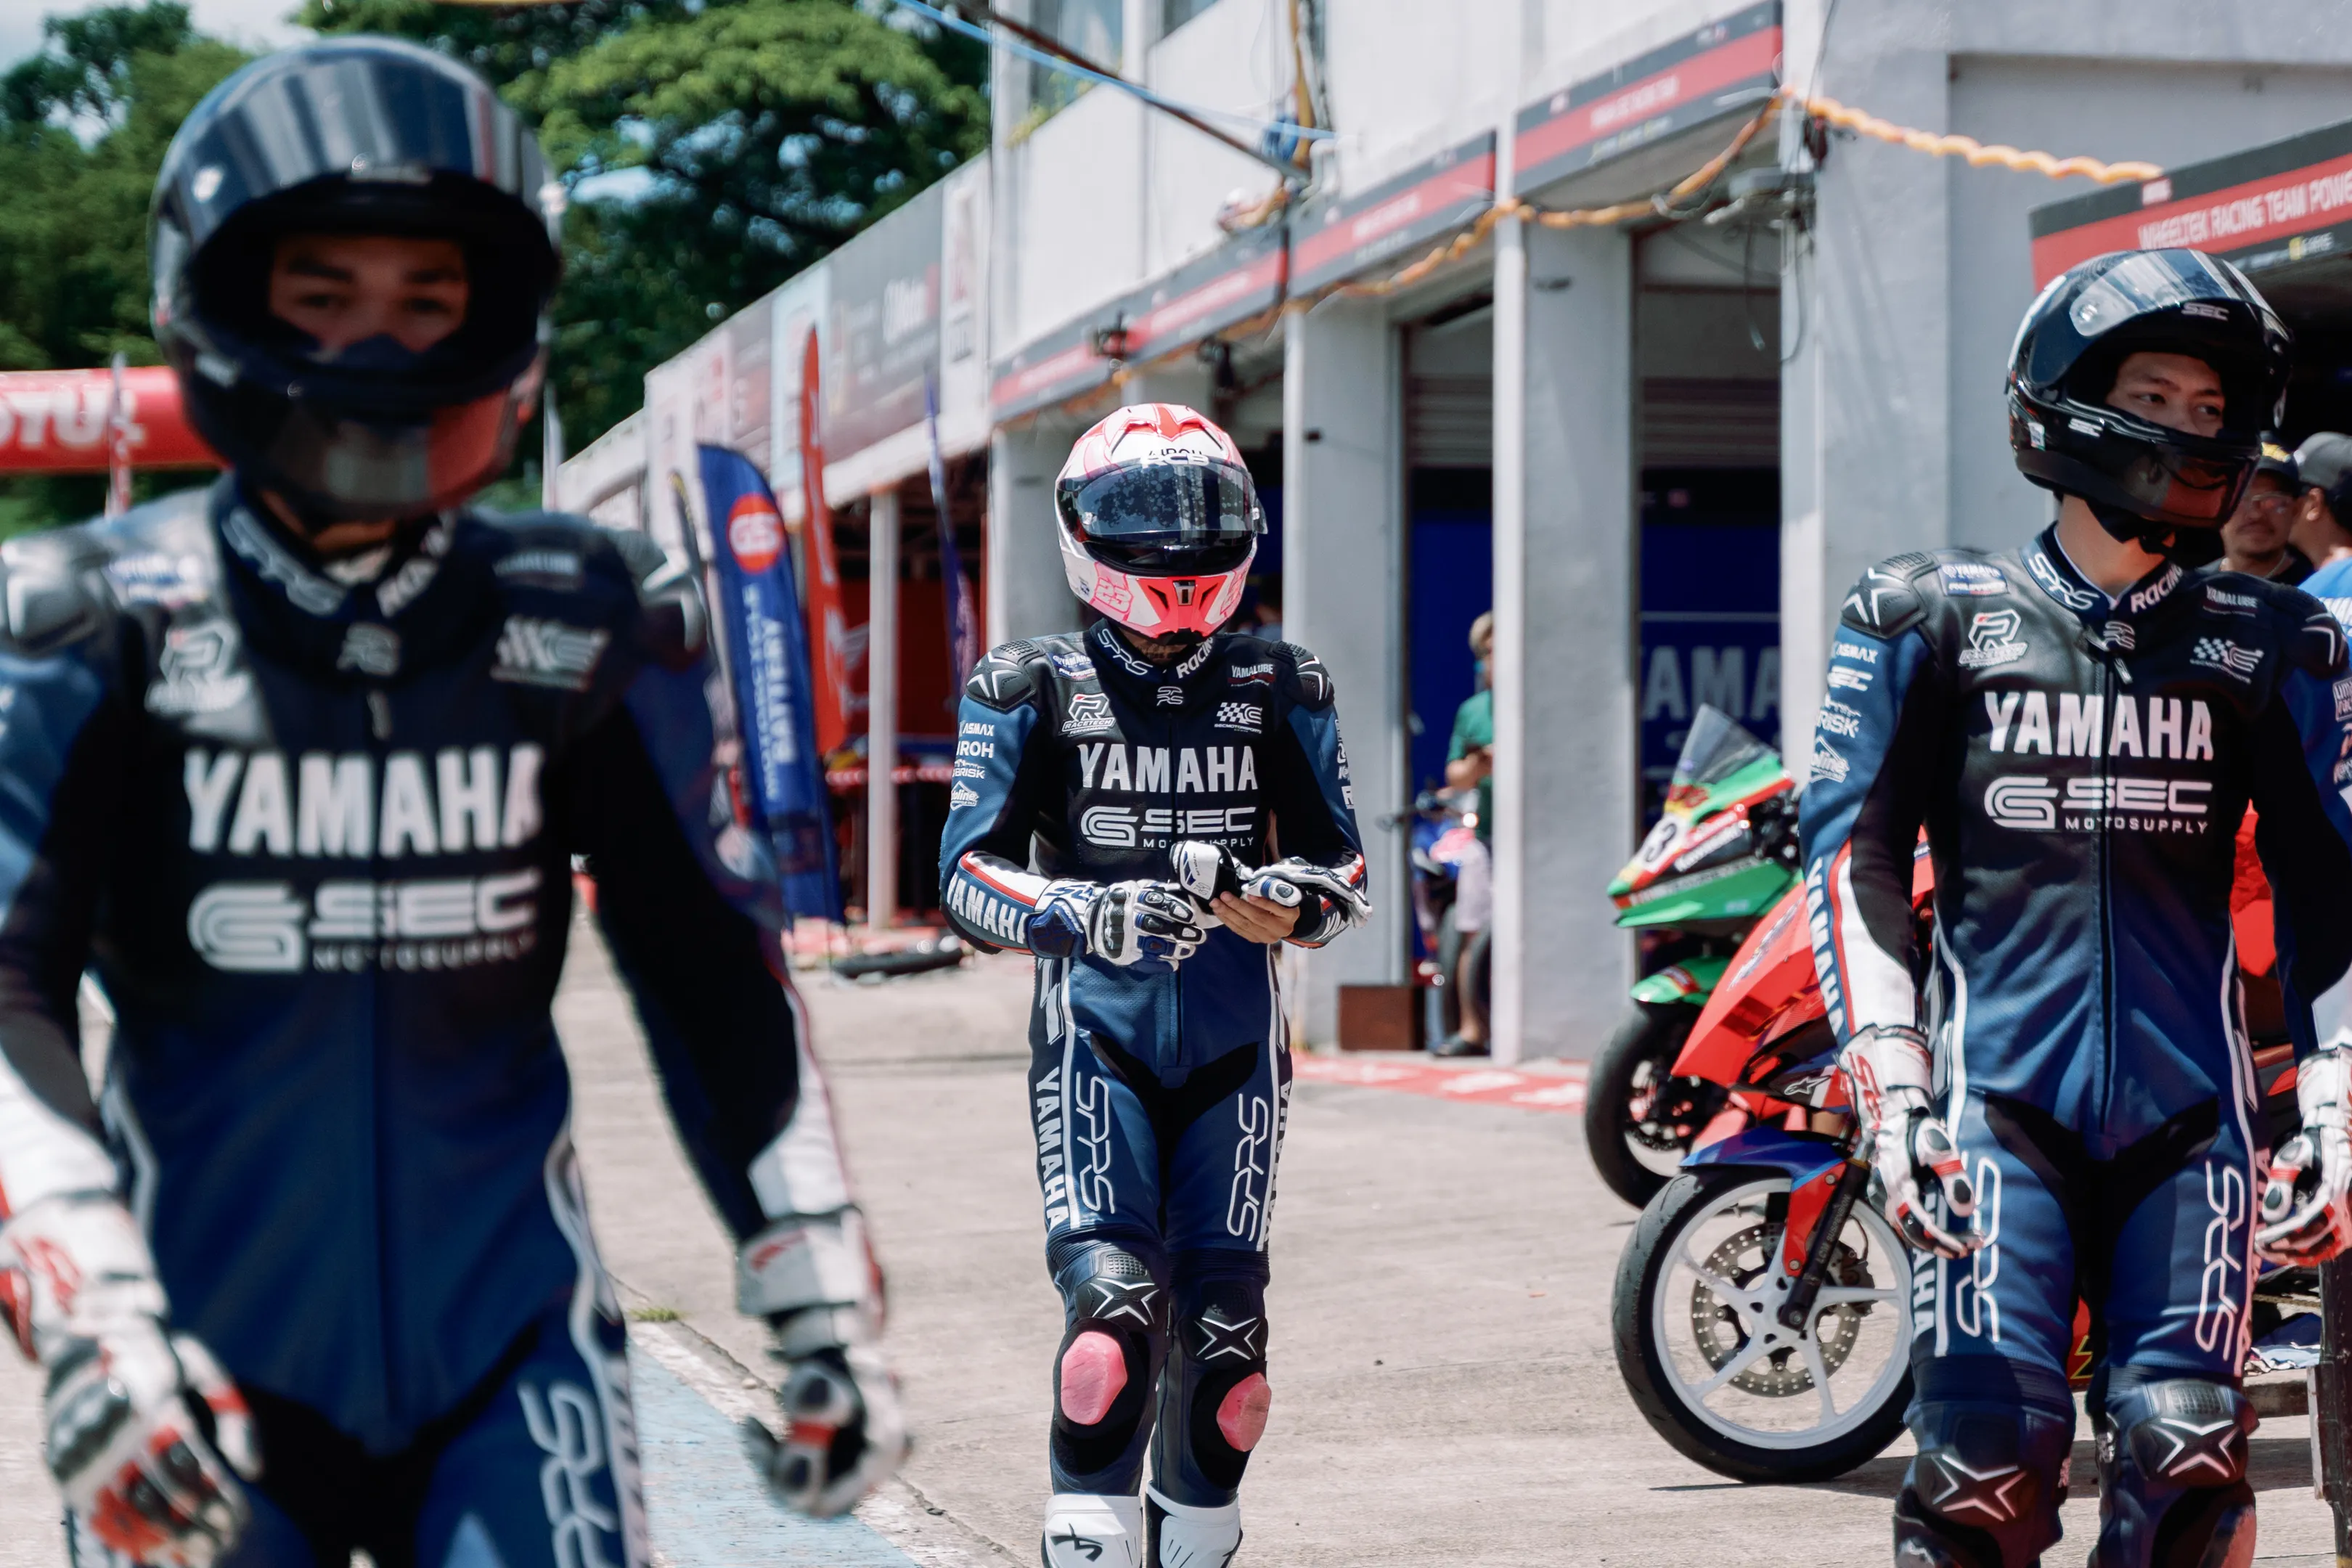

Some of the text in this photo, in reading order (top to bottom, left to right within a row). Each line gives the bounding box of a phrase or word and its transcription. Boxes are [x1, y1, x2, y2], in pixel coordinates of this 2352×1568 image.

[2210, 195, 2265, 234] RACING
[2264, 184, 2307, 224] TEAM
[2181, 302, 2229, 321] SEC
[761, 617, 796, 765] BATTERY
[1231, 663, 1274, 678] YAMALUBE
[1063, 718, 1114, 730] RACETECH
[1985, 691, 2214, 761] YAMAHA
[1077, 743, 1258, 793] YAMAHA
[184, 743, 544, 858] YAMAHA
[2065, 816, 2208, 835] MOTOSUPPLY
[1035, 1066, 1071, 1228] YAMAHA
[1826, 1193, 1852, 1241] SUSPENSION
